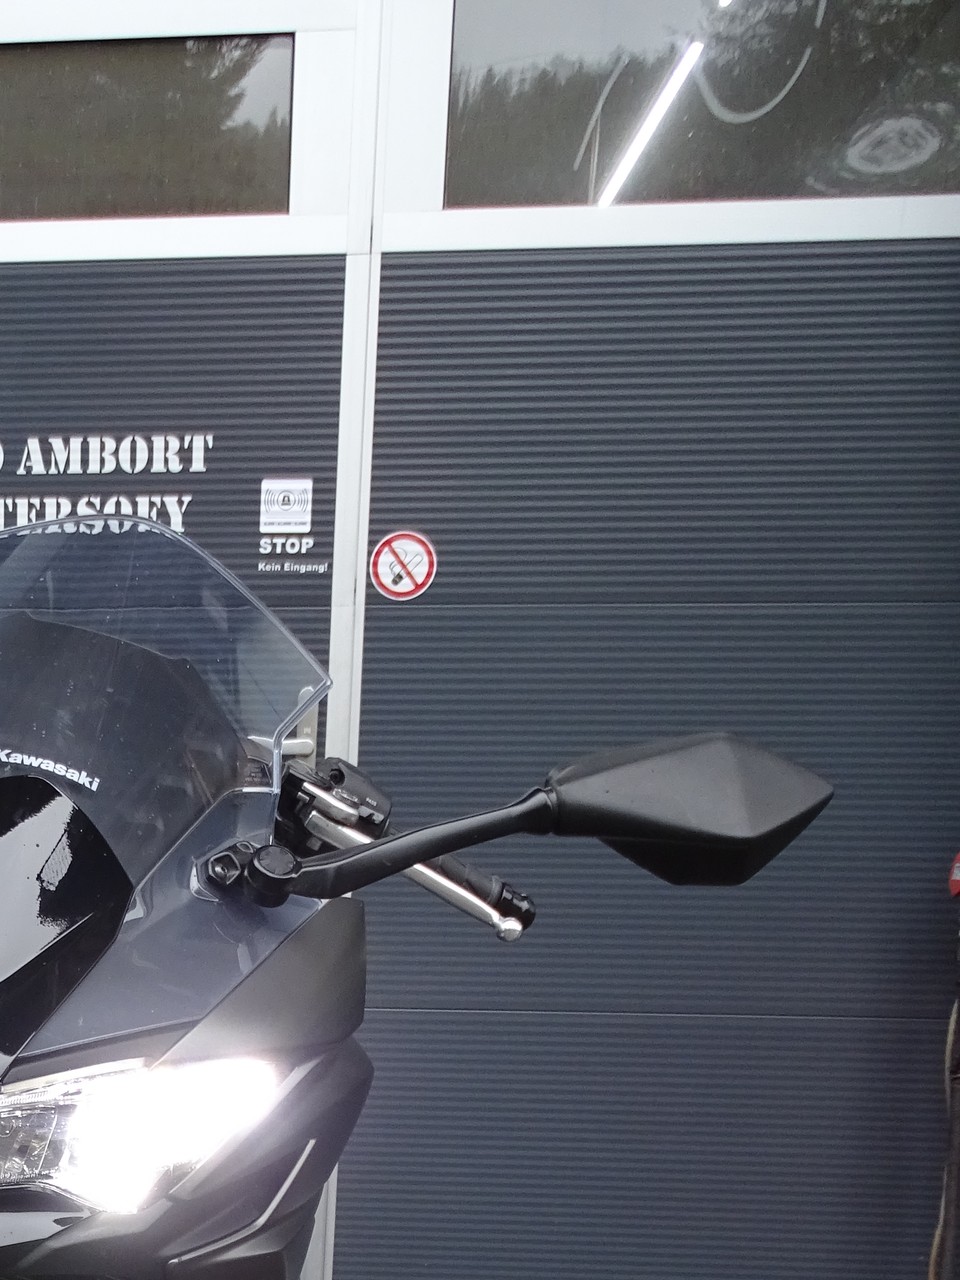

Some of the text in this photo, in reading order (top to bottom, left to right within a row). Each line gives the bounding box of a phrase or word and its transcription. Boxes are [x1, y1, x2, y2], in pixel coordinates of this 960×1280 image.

[16, 434, 214, 475] AMBORT
[259, 537, 314, 554] STOP
[258, 562, 328, 573] Kein Eingang!
